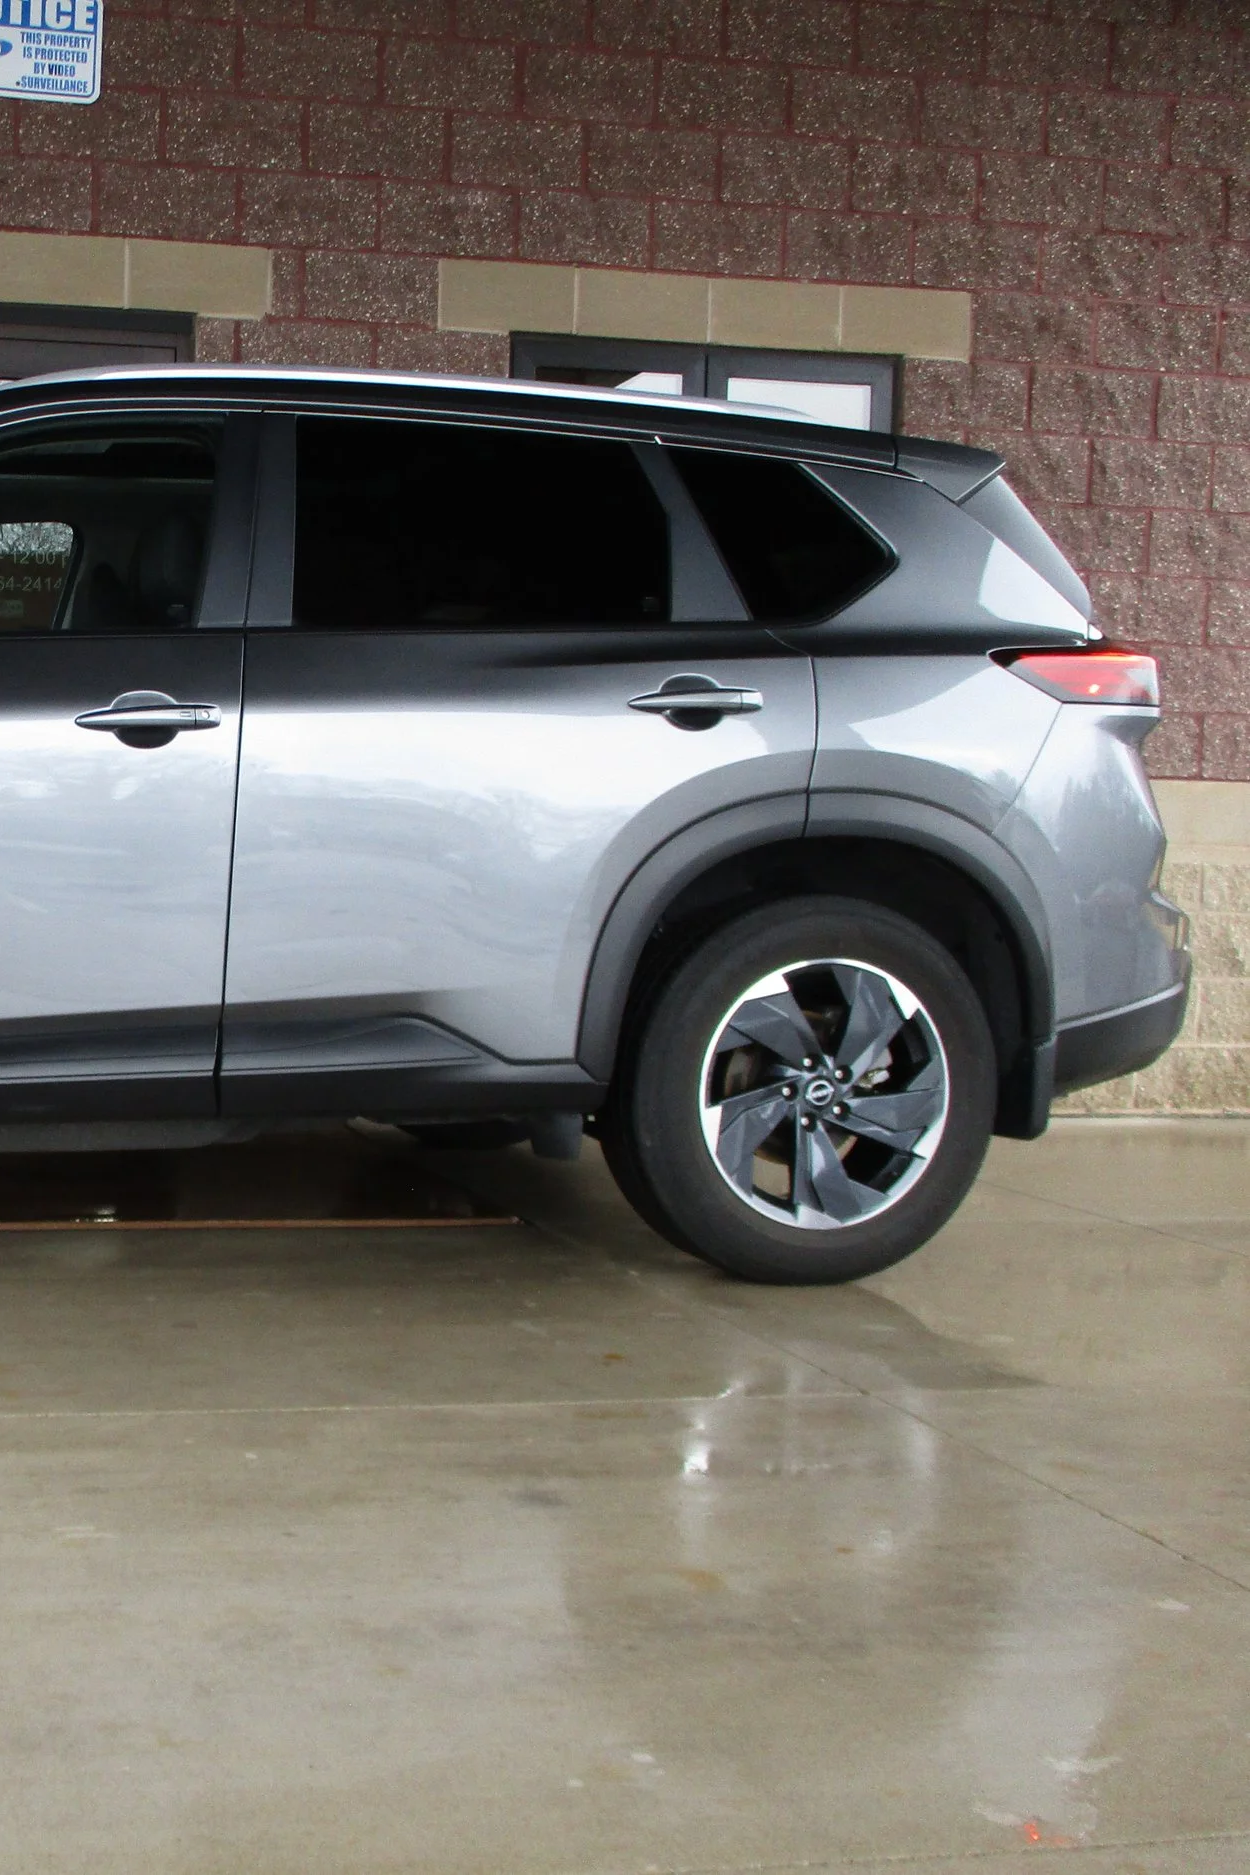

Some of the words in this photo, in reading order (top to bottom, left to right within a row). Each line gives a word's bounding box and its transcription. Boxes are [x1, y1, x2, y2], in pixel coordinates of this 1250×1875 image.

[20, 31, 42, 45] THIS
[44, 33, 92, 49] PROPERTY
[23, 46, 32, 59] IS
[35, 47, 88, 63] PROTECTED
[33, 62, 46, 75] BY
[48, 63, 76, 77] VIDEO
[21, 76, 88, 93] SURVEILLANCE
